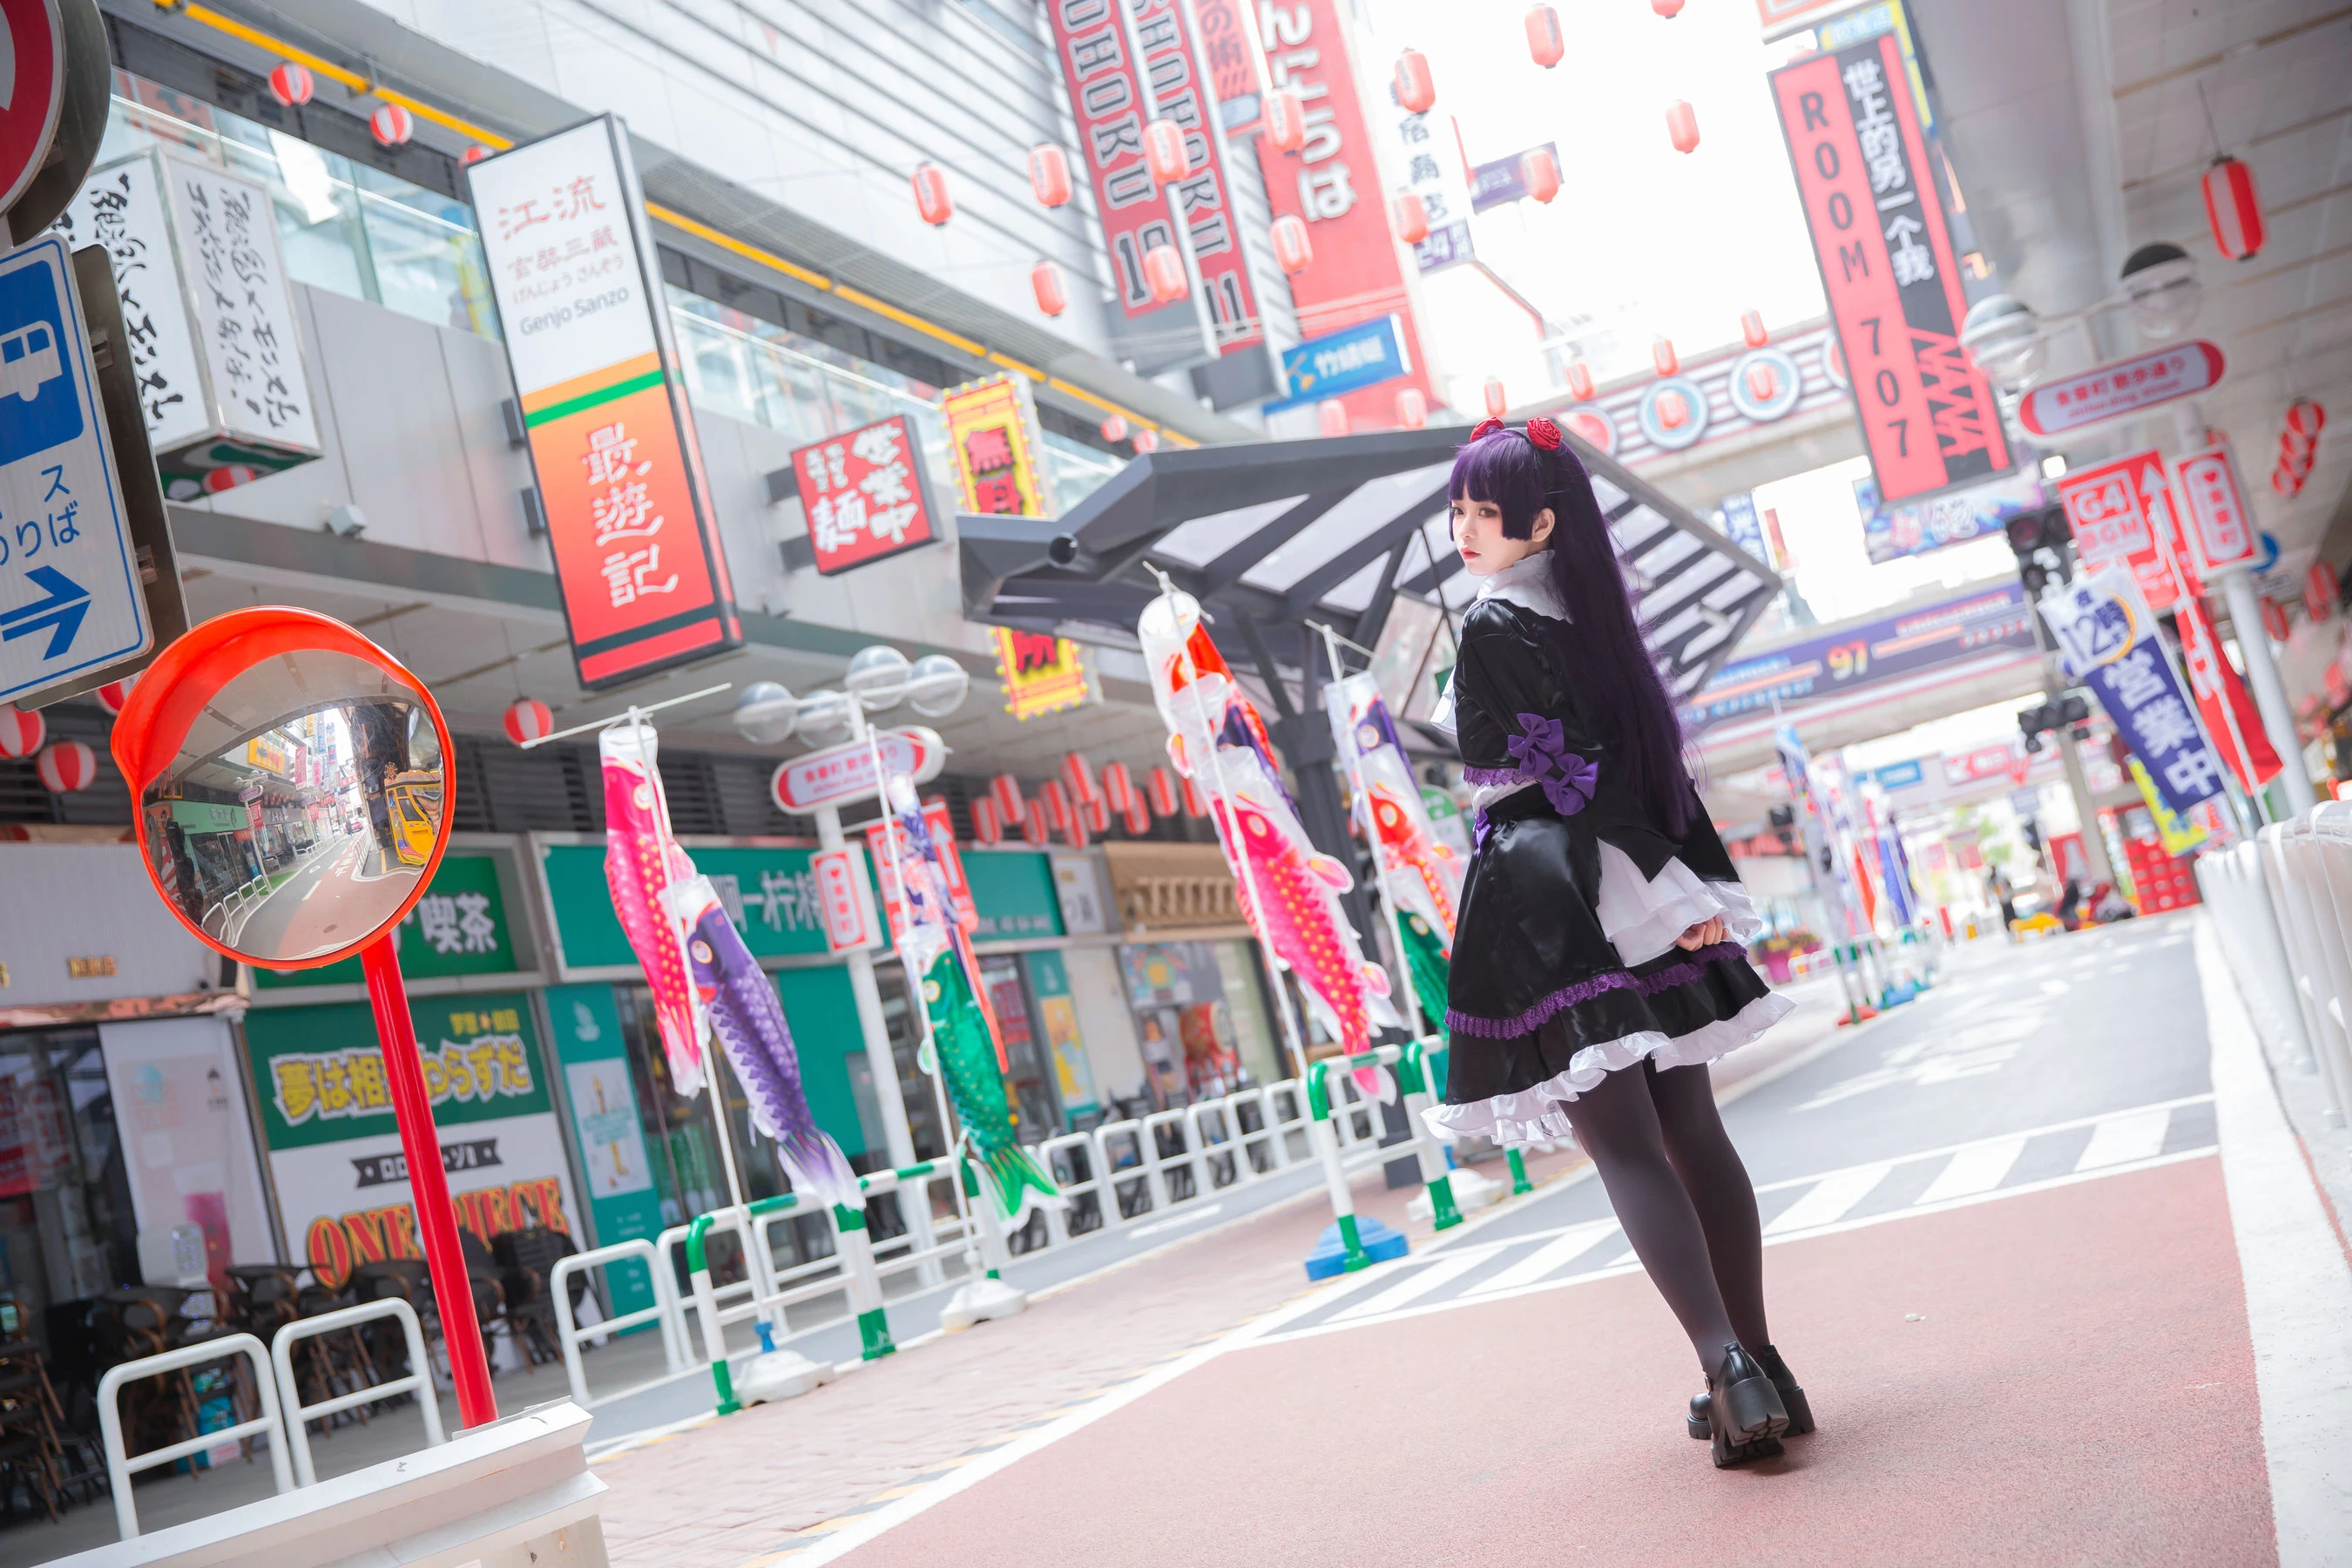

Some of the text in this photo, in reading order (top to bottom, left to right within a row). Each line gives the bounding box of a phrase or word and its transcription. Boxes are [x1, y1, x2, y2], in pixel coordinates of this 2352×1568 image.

[498, 174, 606, 240] 江流
[1842, 57, 1936, 287] 世上的另一个我
[519, 286, 631, 336] Genjo Sanzo
[1800, 91, 1869, 283] ROOM
[1861, 318, 1912, 457] 707
[582, 422, 679, 608] 最遊記
[2102, 647, 2214, 796] 営業中
[307, 1203, 424, 1289] ONE
